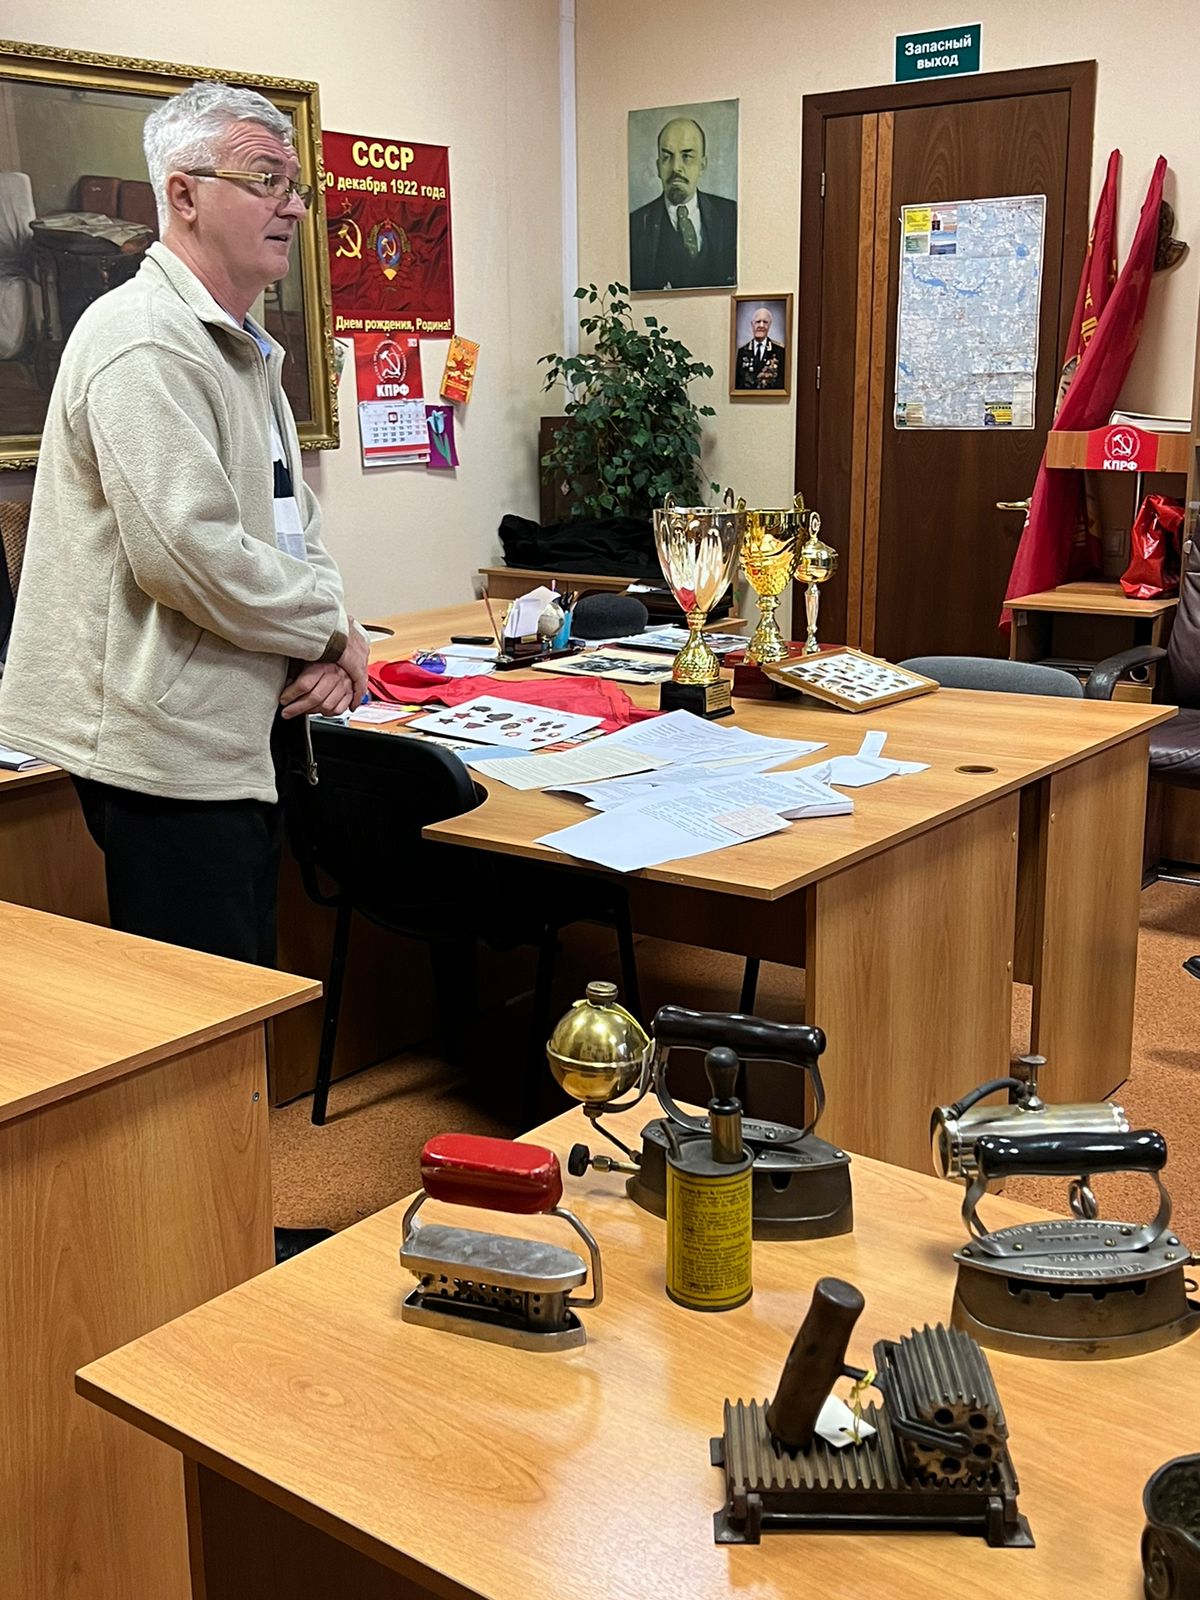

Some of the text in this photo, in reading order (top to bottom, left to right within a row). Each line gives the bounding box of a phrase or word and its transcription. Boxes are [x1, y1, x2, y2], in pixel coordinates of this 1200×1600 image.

[904, 34, 972, 55] Запасный
[917, 55, 959, 69] выход
[352, 141, 414, 171] СССР
[325, 171, 446, 200] 0 декабря 1922 года
[335, 315, 451, 332] Днем рождения, Родина!
[376, 384, 410, 397] КПРФ
[1103, 460, 1138, 470] КПРФ
